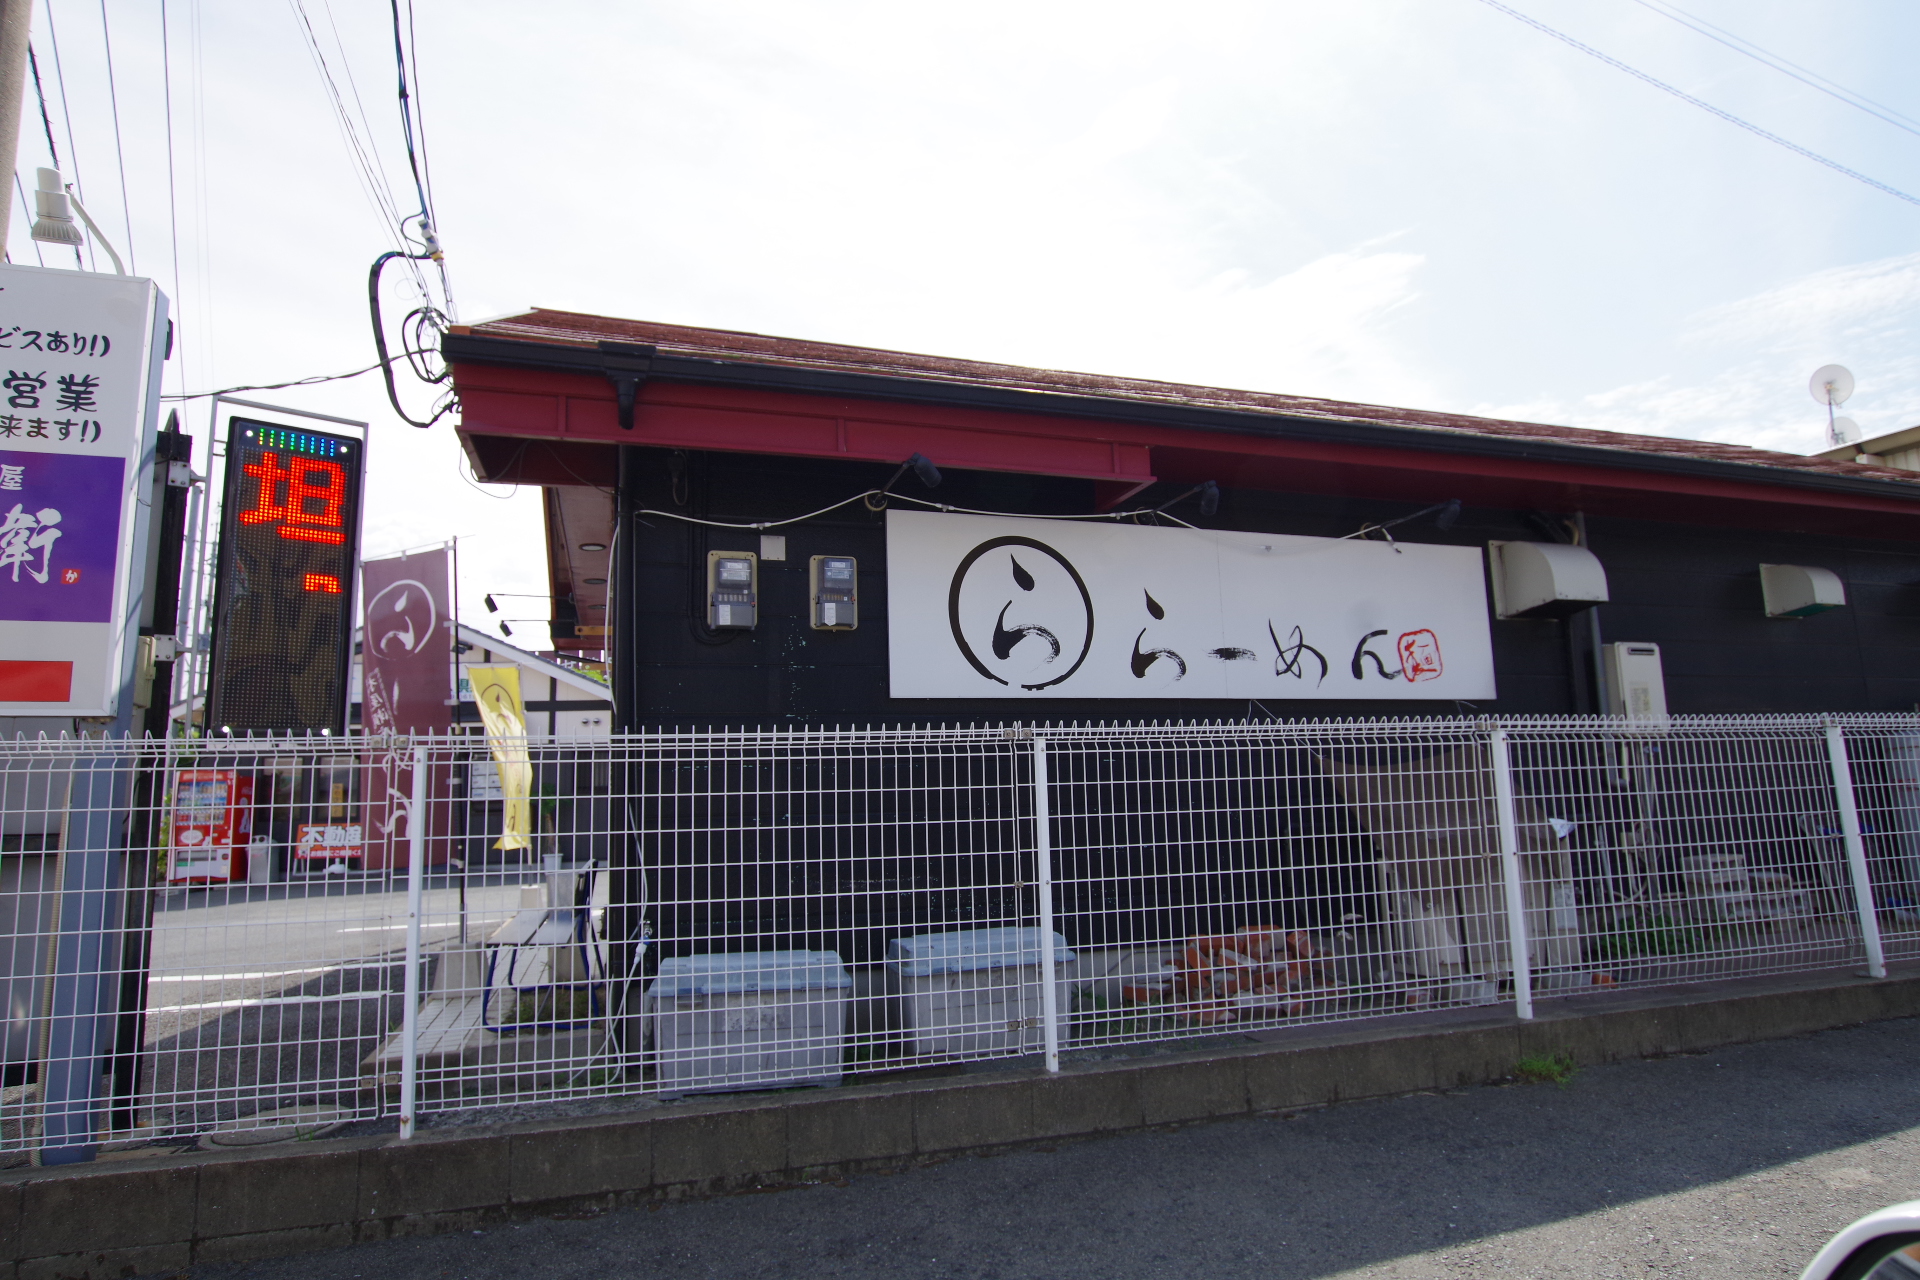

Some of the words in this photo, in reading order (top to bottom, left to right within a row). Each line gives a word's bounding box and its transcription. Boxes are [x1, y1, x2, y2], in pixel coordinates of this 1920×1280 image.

[2, 369, 100, 413] 営業
[0, 464, 25, 491] 屋
[1131, 588, 1403, 689] らーめん
